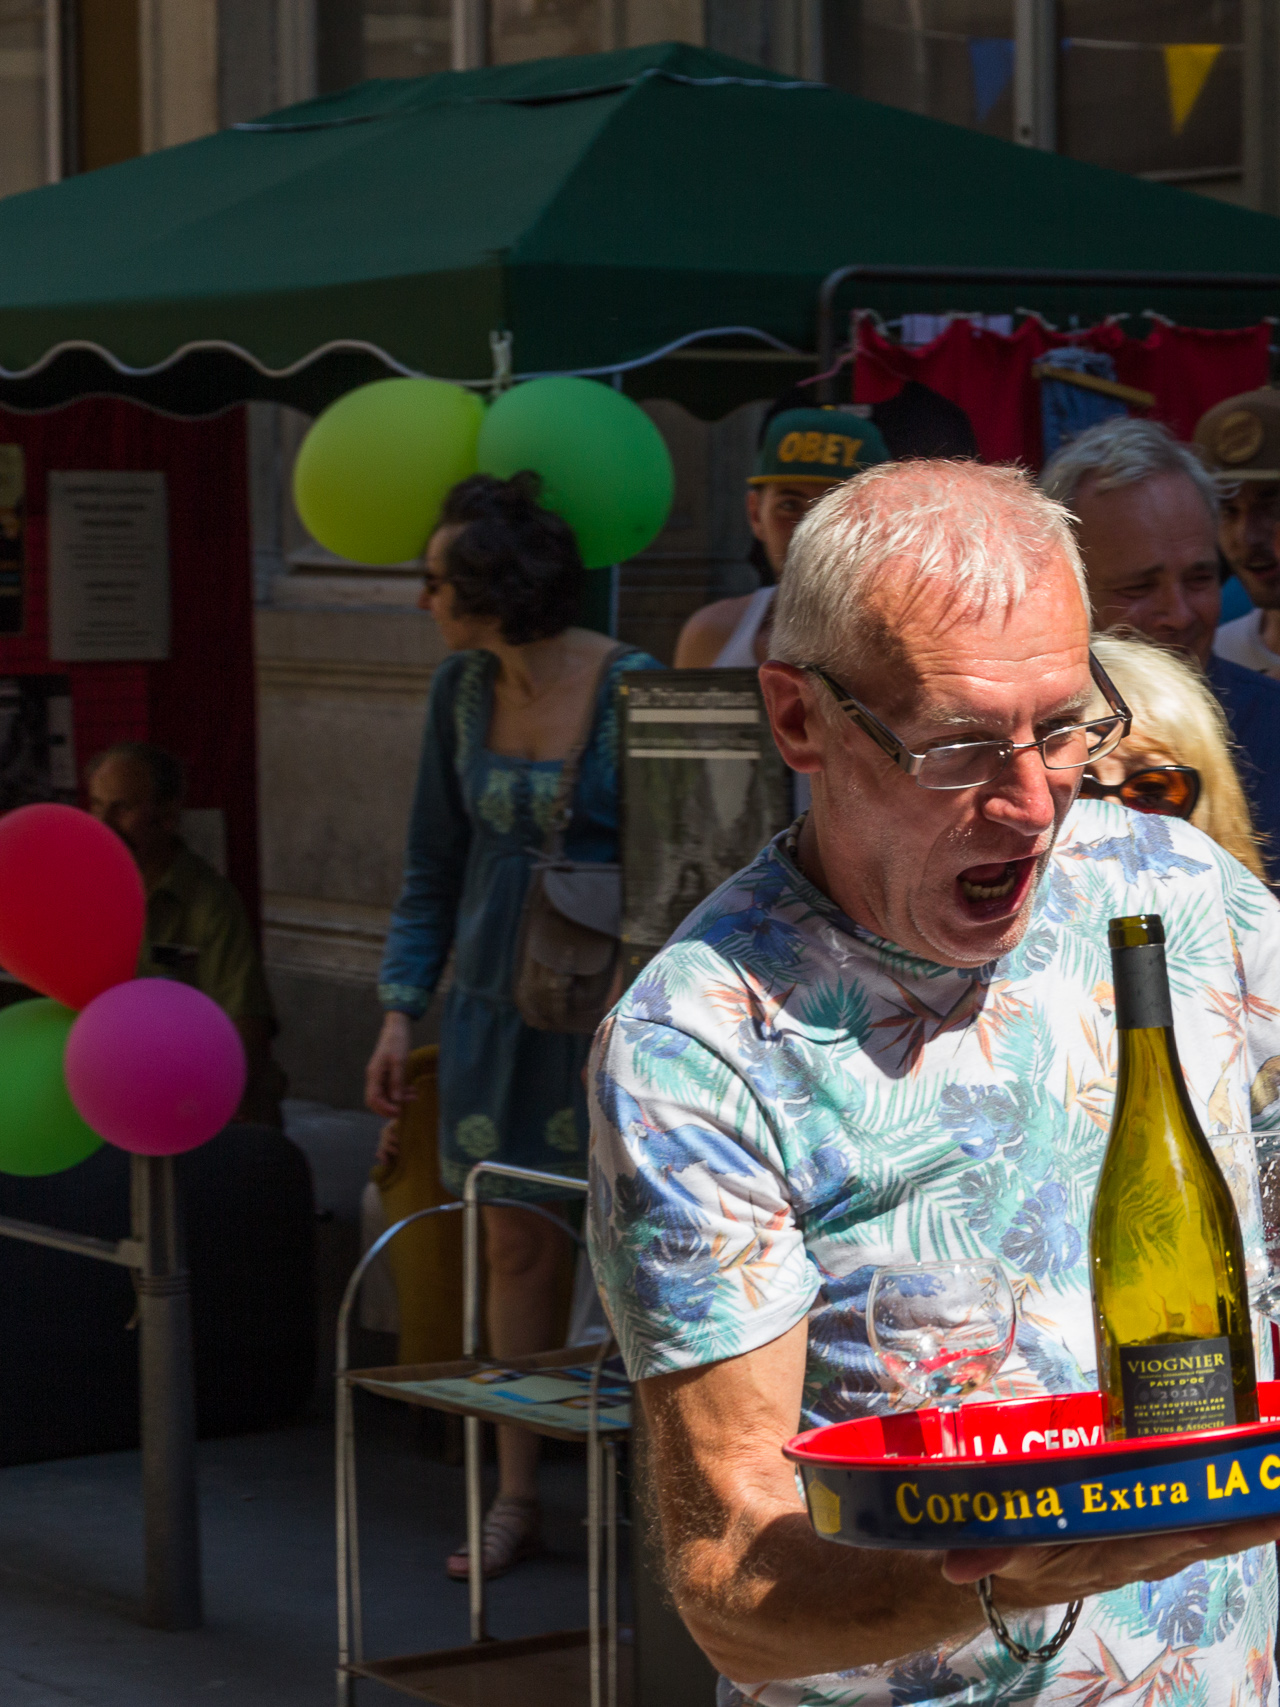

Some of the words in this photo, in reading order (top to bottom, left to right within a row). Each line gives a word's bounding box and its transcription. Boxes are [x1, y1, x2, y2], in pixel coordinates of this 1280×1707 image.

[778, 431, 863, 467] OBEY
[1127, 1353, 1225, 1373] VIOGNIER
[1149, 1379, 1175, 1387] PAYS
[1179, 1376, 1205, 1386] D'OC
[1160, 1387, 1199, 1400] 2012
[1195, 1403, 1225, 1413] FRANCE
[896, 1482, 1063, 1525] Corona
[1080, 1480, 1189, 1514] Extra
[1206, 1460, 1250, 1500] LA
